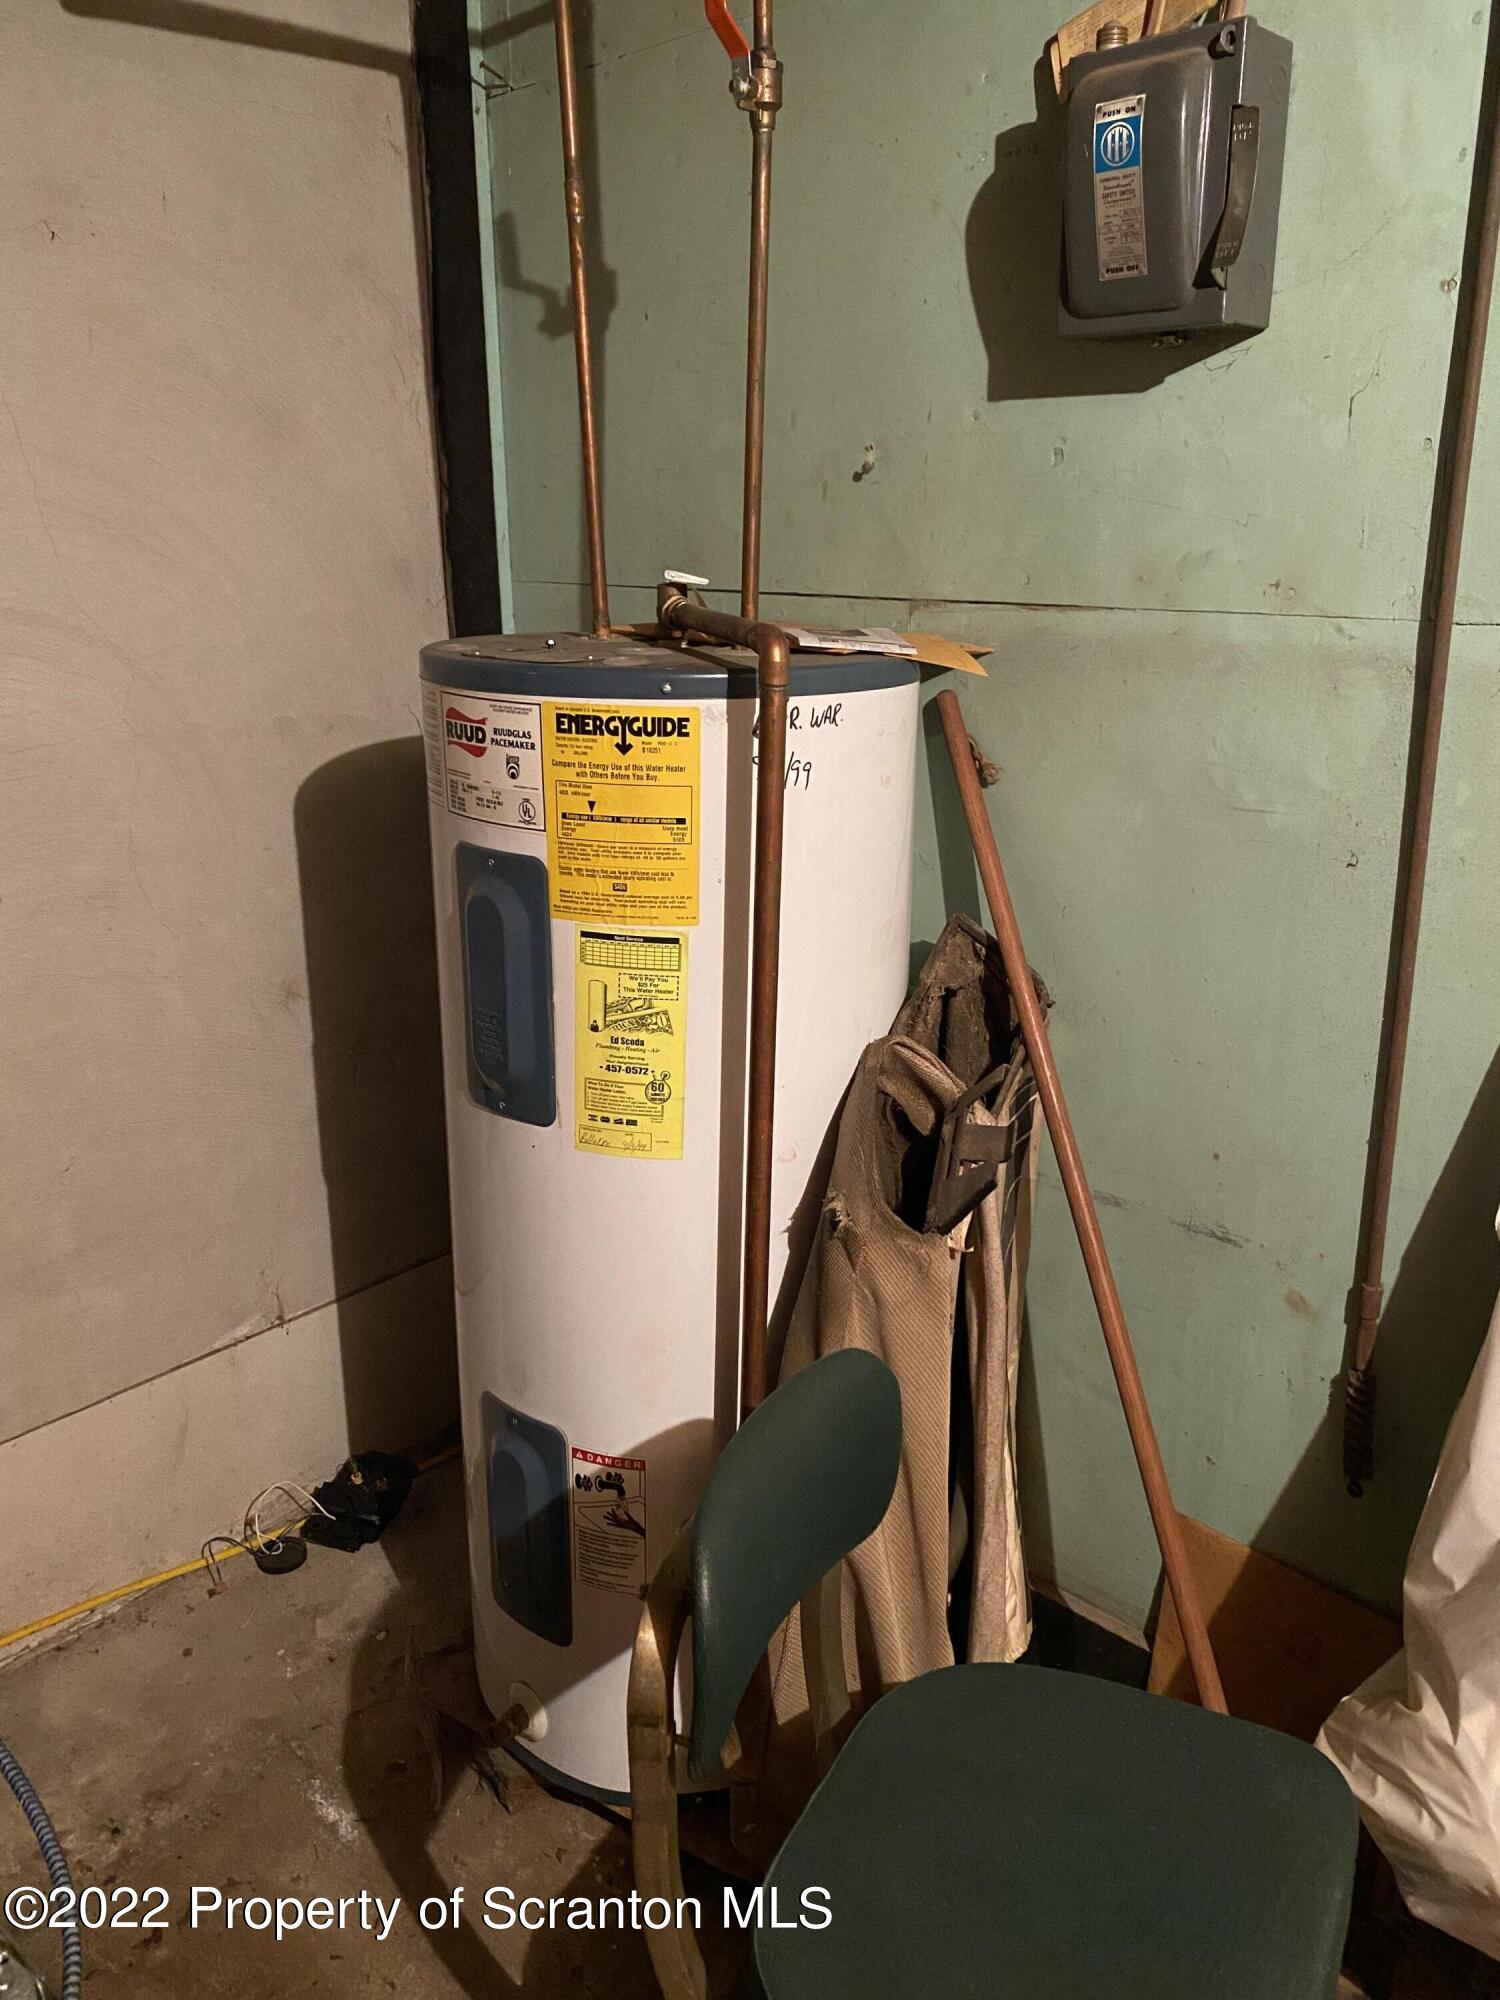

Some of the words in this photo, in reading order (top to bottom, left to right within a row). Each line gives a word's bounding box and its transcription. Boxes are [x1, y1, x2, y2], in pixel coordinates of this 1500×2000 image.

[1103, 109, 1121, 118] PUSH
[556, 712, 690, 737] ENERGYGUIDE
[446, 720, 486, 744] RUUD
[493, 728, 531, 739] RUUDGLAS
[491, 738, 536, 750] PACEMAKER
[552, 759, 576, 768] Compare
[578, 761, 587, 769] the
[589, 762, 609, 770] Energy
[589, 771, 609, 779] Others
[611, 772, 630, 780] Before
[646, 773, 660, 782] Buy.
[611, 1036, 619, 1044] Ed
[621, 1037, 644, 1046] Scoda
[595, 1043, 620, 1051] Plumbing
[605, 1064, 648, 1075] 457-0572
[651, 1082, 664, 1092] 60
[587, 1453, 641, 1469] DANGER
